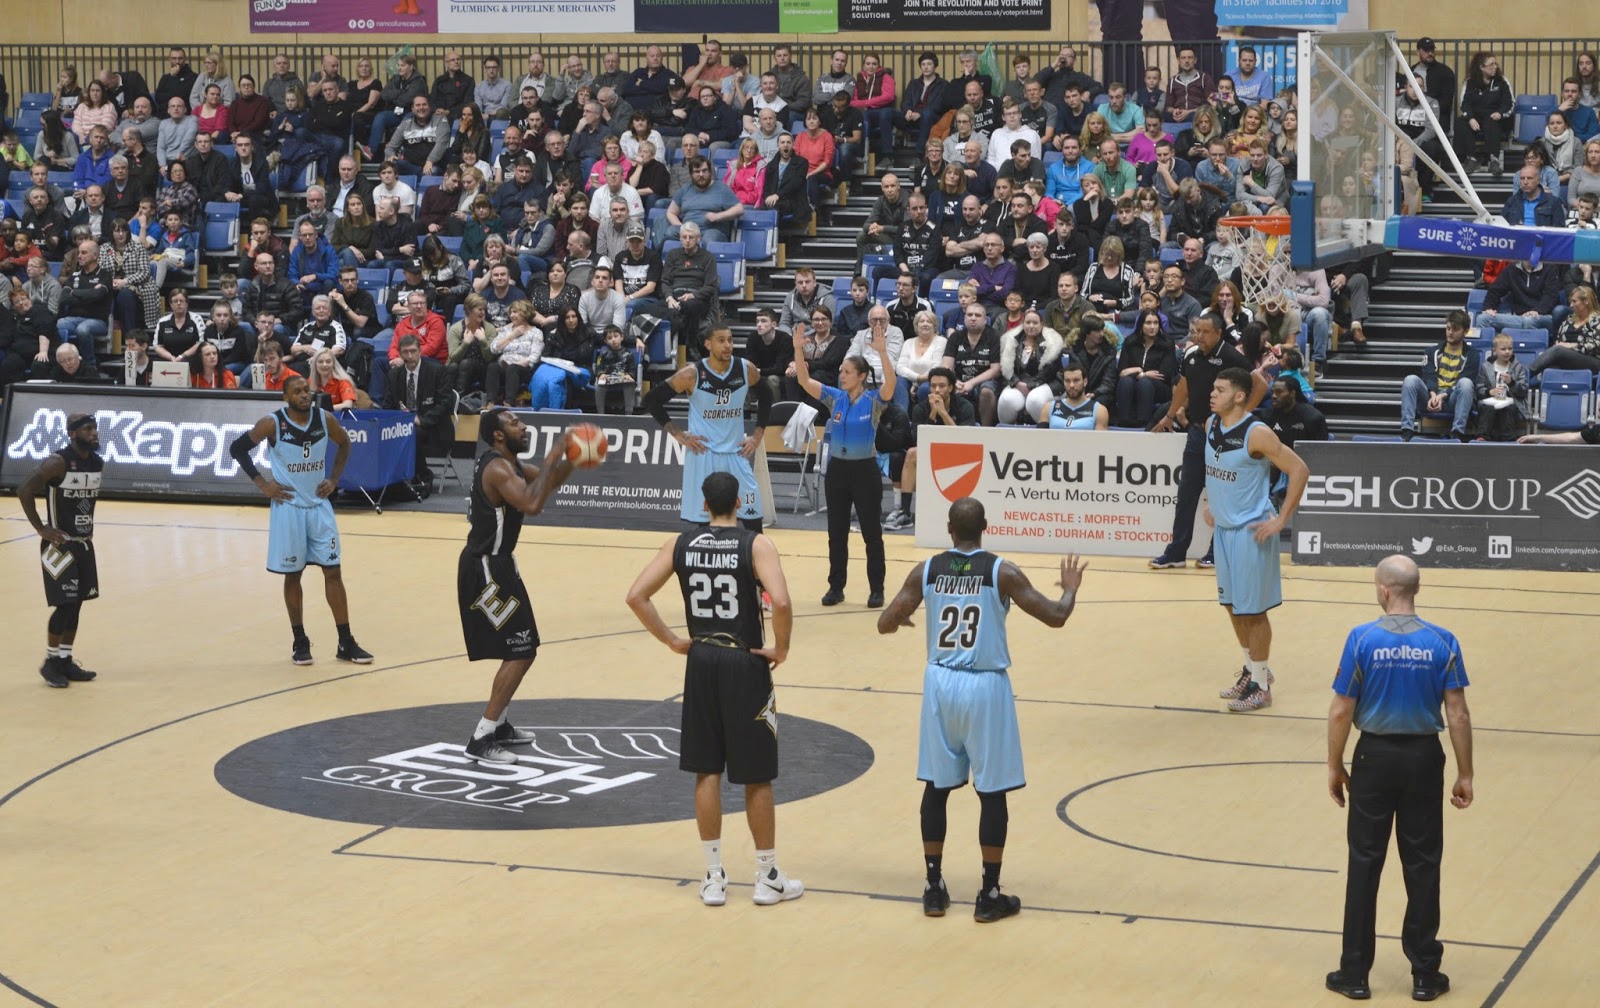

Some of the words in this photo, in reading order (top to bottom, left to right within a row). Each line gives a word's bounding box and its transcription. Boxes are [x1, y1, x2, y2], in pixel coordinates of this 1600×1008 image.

[254, 0, 273, 12] FUN
[450, 5, 500, 13] PLUMBING
[501, 5, 509, 13] &
[511, 5, 555, 13] PIPELINE
[557, 5, 616, 13] MERCHANTS
[903, 9, 1044, 17] www.northernprintsolutions.co.uk/voteprint.html
[1418, 227, 1453, 242] SURE
[1480, 235, 1516, 250] SHOT
[127, 352, 133, 360] 3
[128, 360, 133, 369] 2
[716, 388, 732, 405] 13
[703, 408, 742, 420] SCORCHERS
[303, 441, 311, 459] 5
[1213, 445, 1222, 463] 4
[989, 451, 1084, 484] Vertu
[557, 484, 579, 495] JOIN
[582, 485, 599, 496] THE
[602, 486, 661, 499] REVOLUTION
[662, 488, 683, 500] AND
[745, 493, 756, 505] 13
[1005, 487, 1017, 499] A
[1021, 487, 1061, 501] Vertu
[1065, 488, 1120, 503] Motors
[1300, 475, 1381, 508] ESH
[1389, 476, 1542, 512] GROUP
[1004, 511, 1075, 523] NEWCASTLE
[1084, 514, 1141, 526] MORPETH
[1054, 528, 1105, 540] DURHAM
[331, 537, 336, 550] 5
[1323, 541, 1404, 553] facebook.com/eshholdings
[1436, 545, 1477, 553] @Esh_Group
[685, 551, 739, 569] WILLIAMS
[934, 574, 984, 596] OWUMI
[689, 572, 739, 619] 23
[937, 603, 982, 651] 23
[1373, 645, 1433, 661] molten
[368, 742, 657, 795] ESH
[323, 765, 571, 808] GROUP
